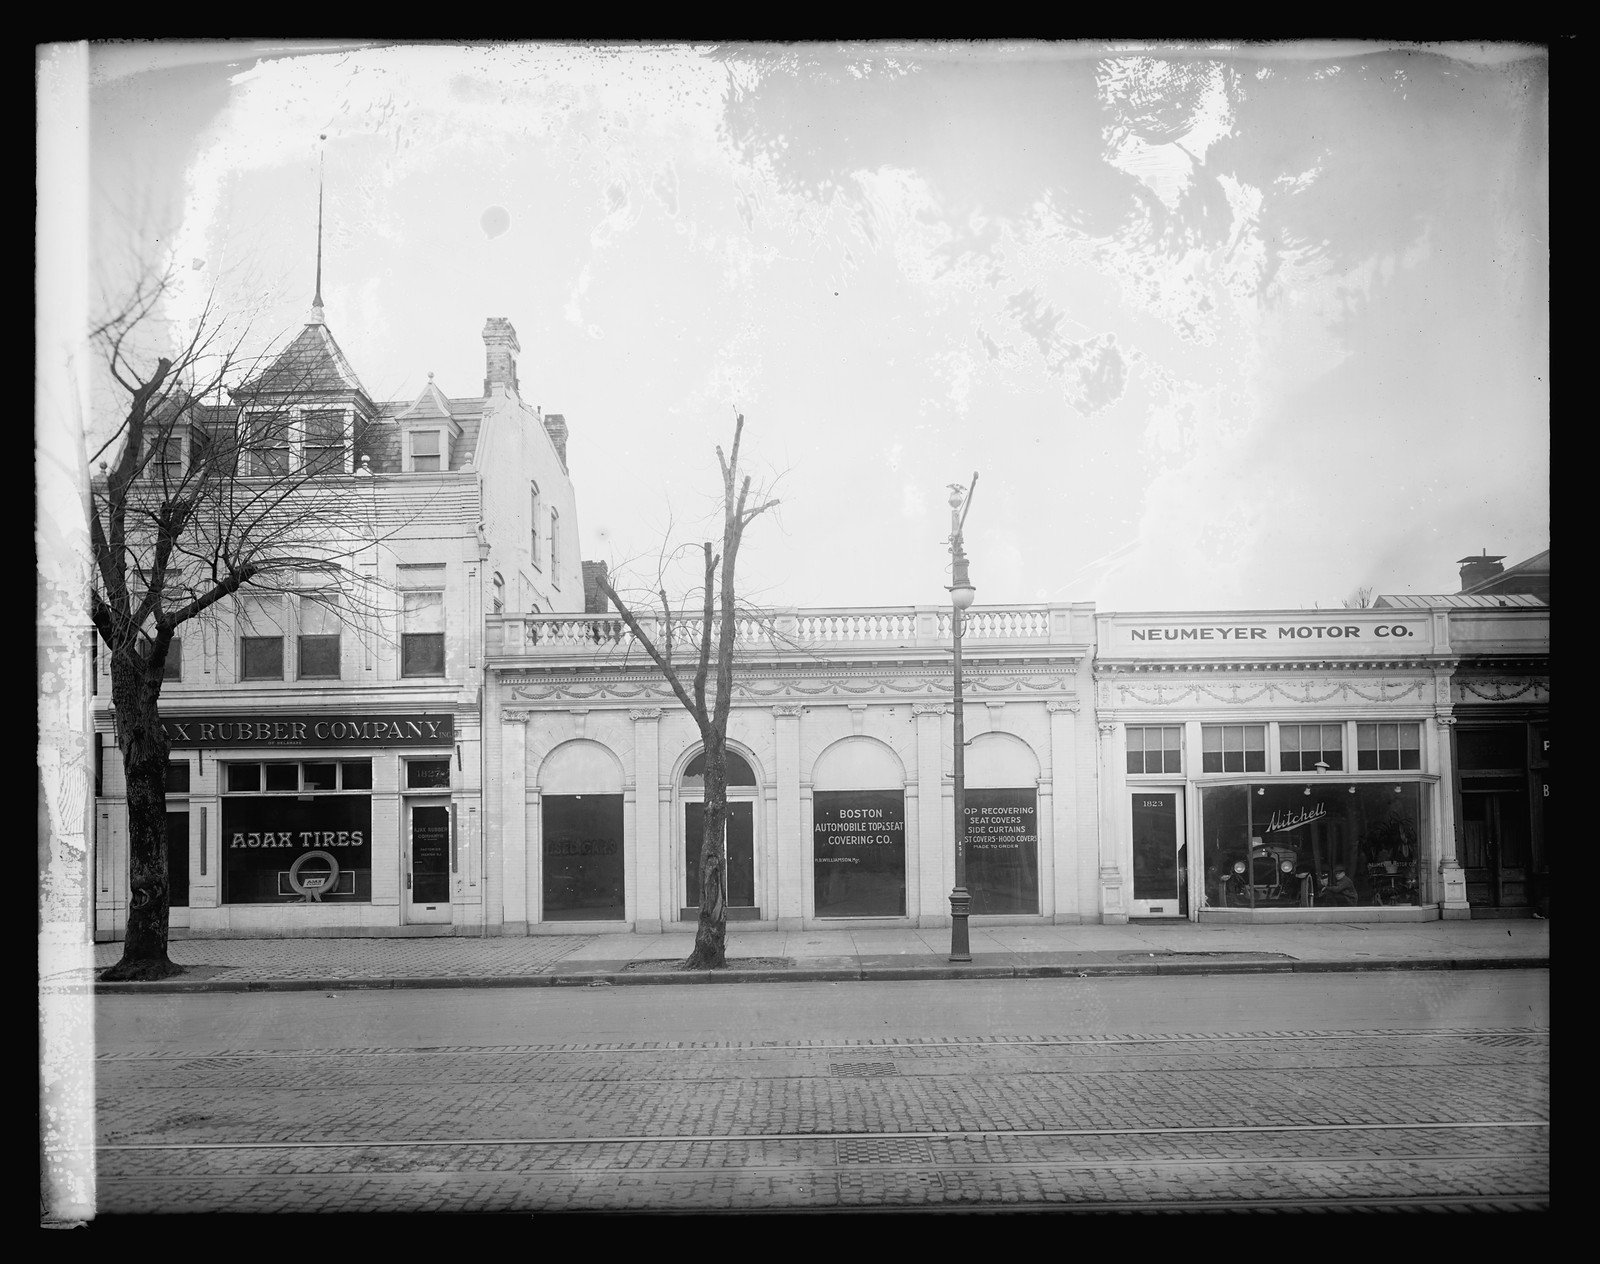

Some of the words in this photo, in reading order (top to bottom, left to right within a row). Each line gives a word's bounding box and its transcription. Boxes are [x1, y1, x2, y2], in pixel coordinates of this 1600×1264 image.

[1131, 627, 1267, 641] NEUMEYER
[1278, 626, 1361, 639] MOTOR
[1374, 625, 1414, 637] CO.
[198, 722, 308, 740] RUBBER
[314, 721, 442, 739] COMPANY
[839, 809, 882, 818] BOSTON
[981, 807, 1034, 815] RECOVERING
[970, 816, 989, 824] SEAT
[991, 816, 1021, 824] COVERS
[1265, 802, 1327, 833] Mitchell
[814, 822, 866, 832] AUTOMOBILE
[988, 825, 1026, 833] CURTAINS
[230, 832, 293, 848] AJAX
[299, 830, 364, 847] TIRES
[828, 835, 874, 845] COVERING
[876, 835, 892, 844] CO.
